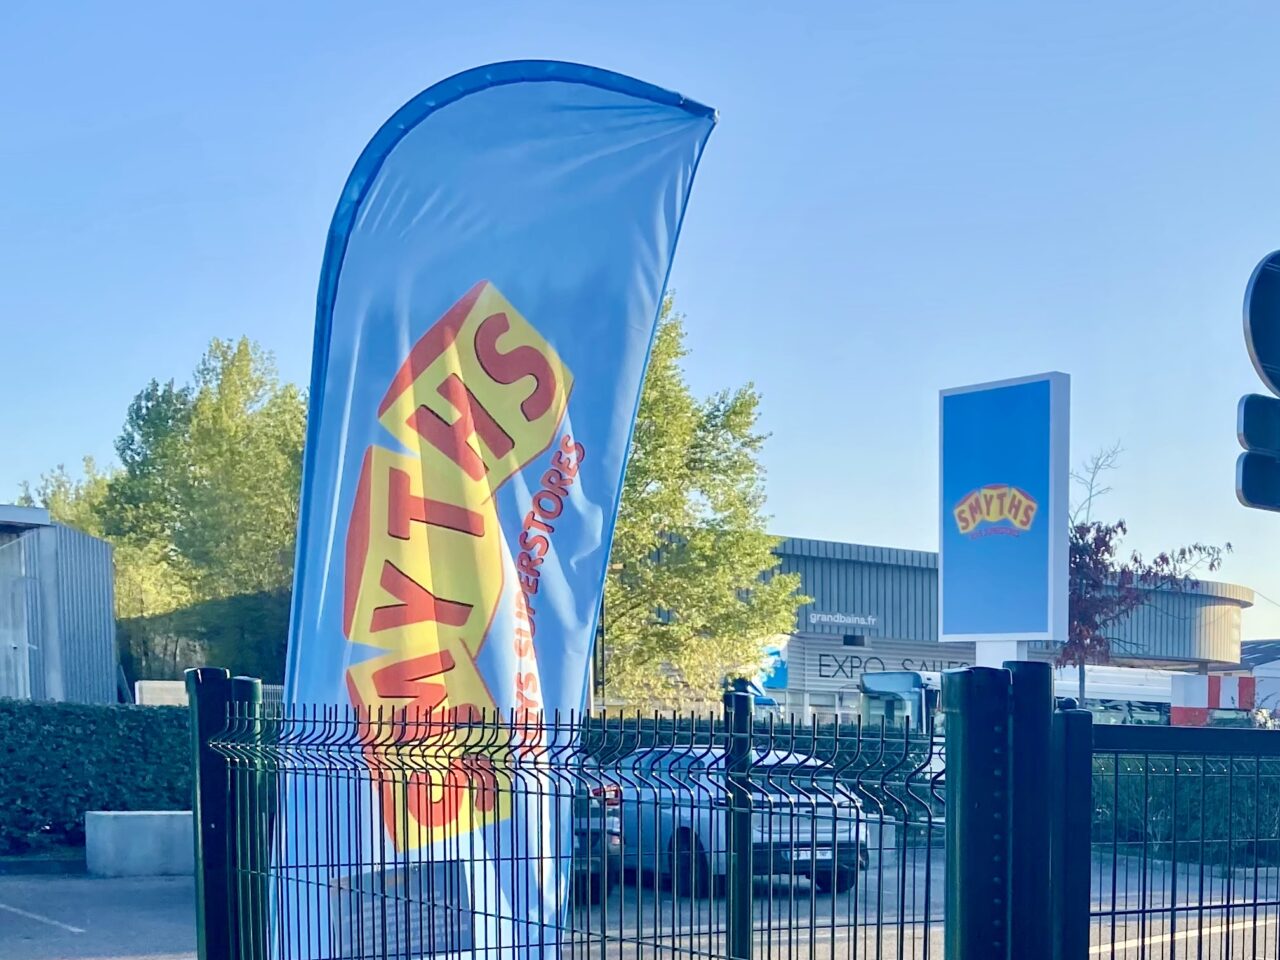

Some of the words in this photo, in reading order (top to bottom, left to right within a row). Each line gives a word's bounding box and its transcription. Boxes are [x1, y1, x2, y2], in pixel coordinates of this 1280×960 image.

[957, 491, 1034, 531] SMYTHS
[513, 434, 585, 664] SUPERSTORES
[369, 312, 556, 828] SMYTHS
[809, 612, 877, 625] grandbains.fr
[818, 653, 886, 679] EXPO
